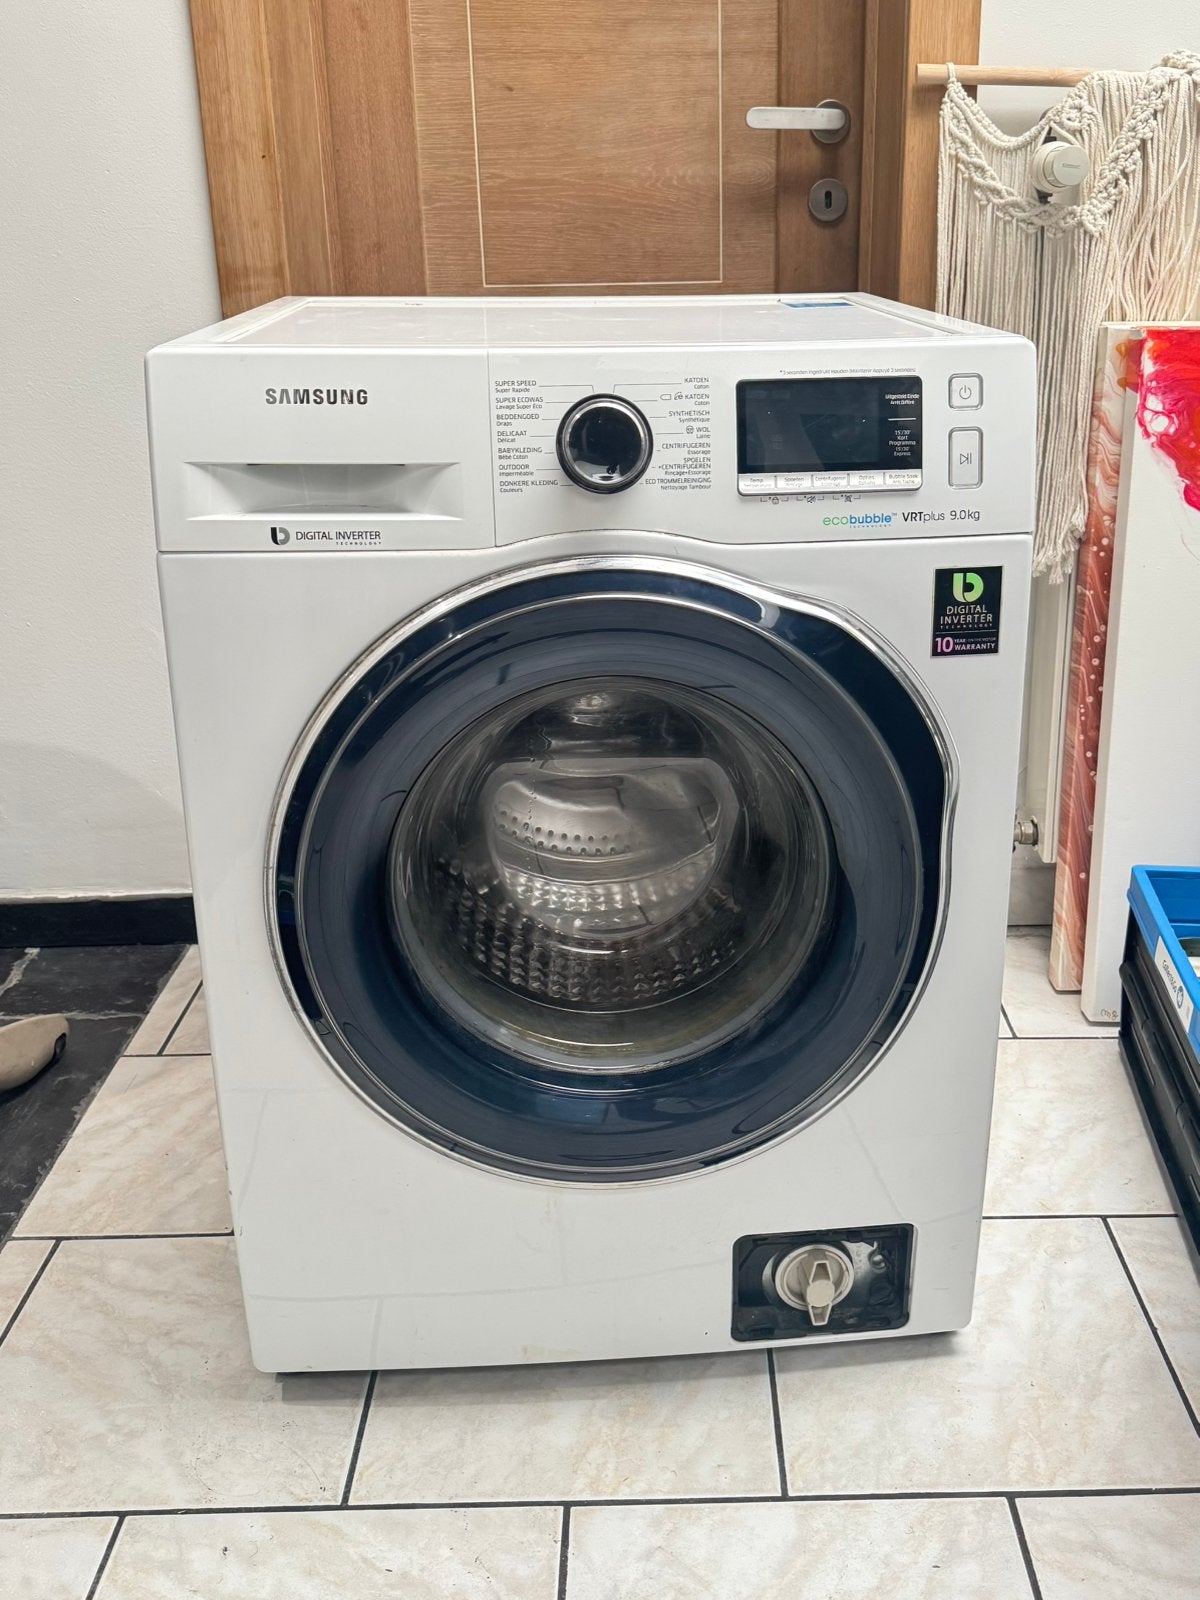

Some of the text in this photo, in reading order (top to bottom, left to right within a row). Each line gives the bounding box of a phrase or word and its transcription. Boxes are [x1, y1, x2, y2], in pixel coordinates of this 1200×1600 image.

[266, 388, 368, 405] SAMSUNG
[902, 511, 945, 523] VRTplus
[296, 531, 381, 540] DIGITAL INVERTER
[946, 605, 987, 614] DIGITAL
[940, 614, 992, 624] INVERTER
[935, 636, 954, 653] 10
